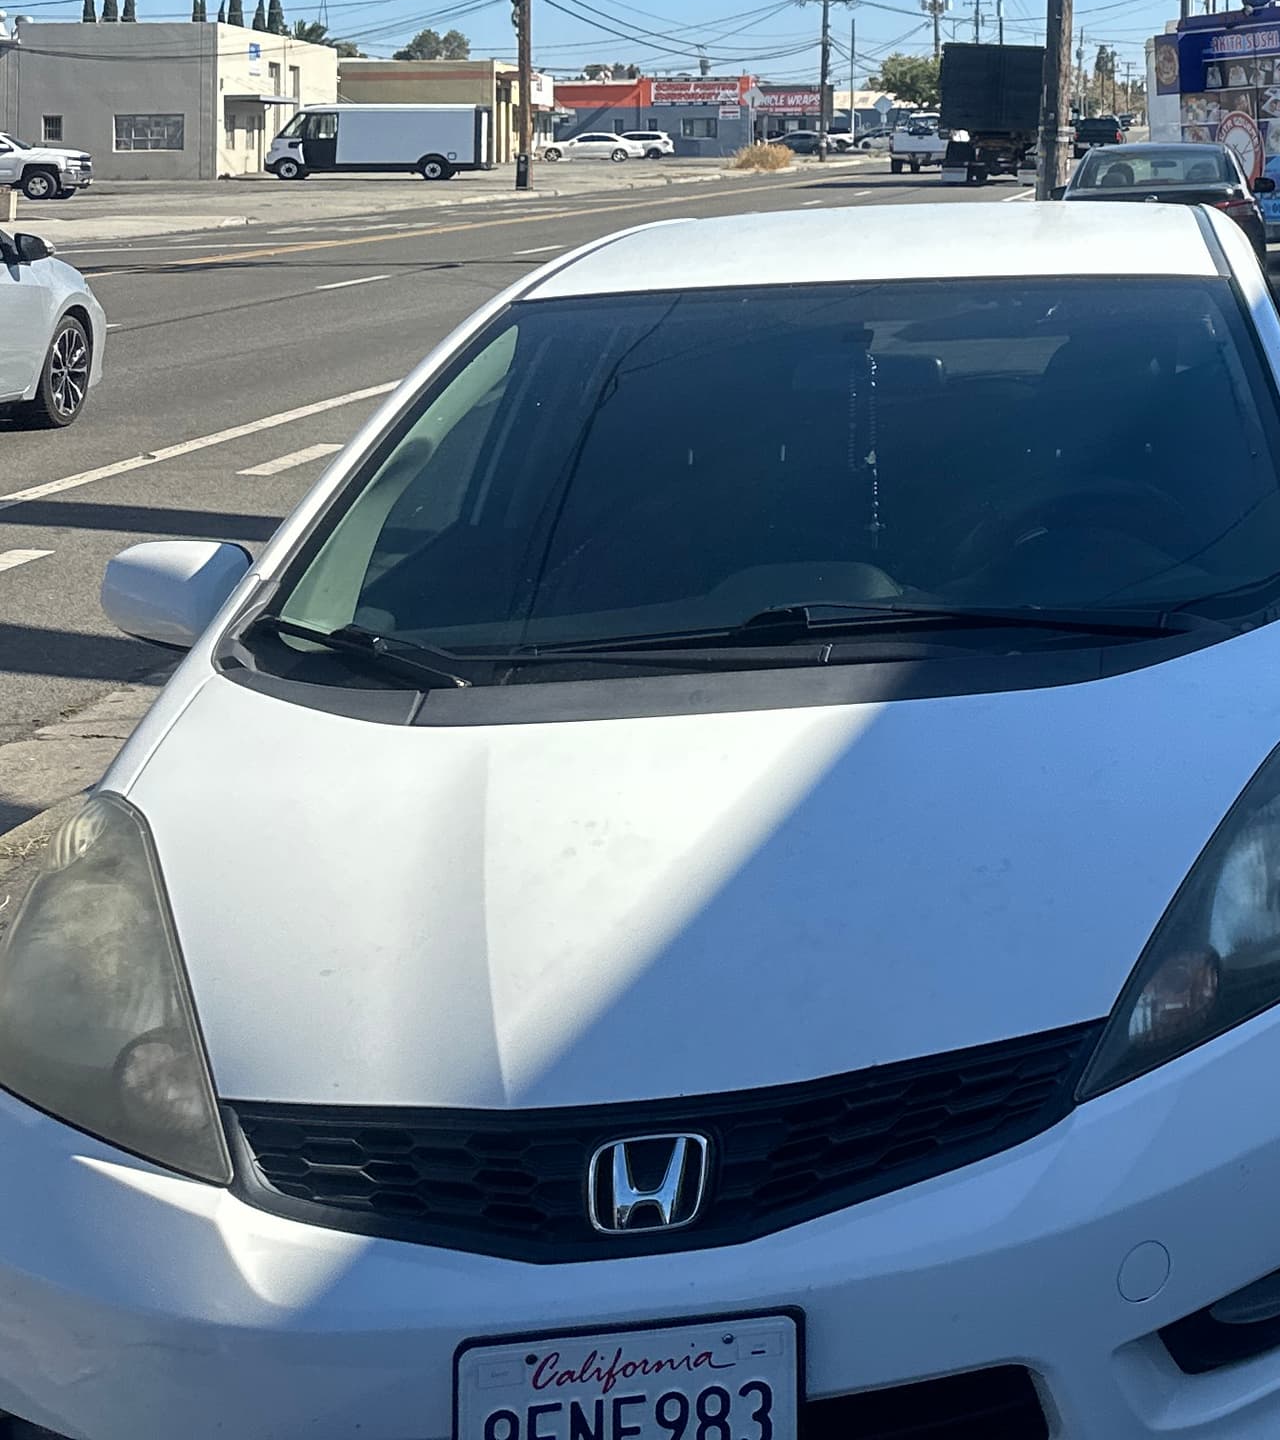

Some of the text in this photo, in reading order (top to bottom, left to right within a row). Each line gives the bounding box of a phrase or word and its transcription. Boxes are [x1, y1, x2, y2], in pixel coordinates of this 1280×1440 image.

[1211, 30, 1280, 52] AKITA SUSHI
[531, 1343, 736, 1394] California
